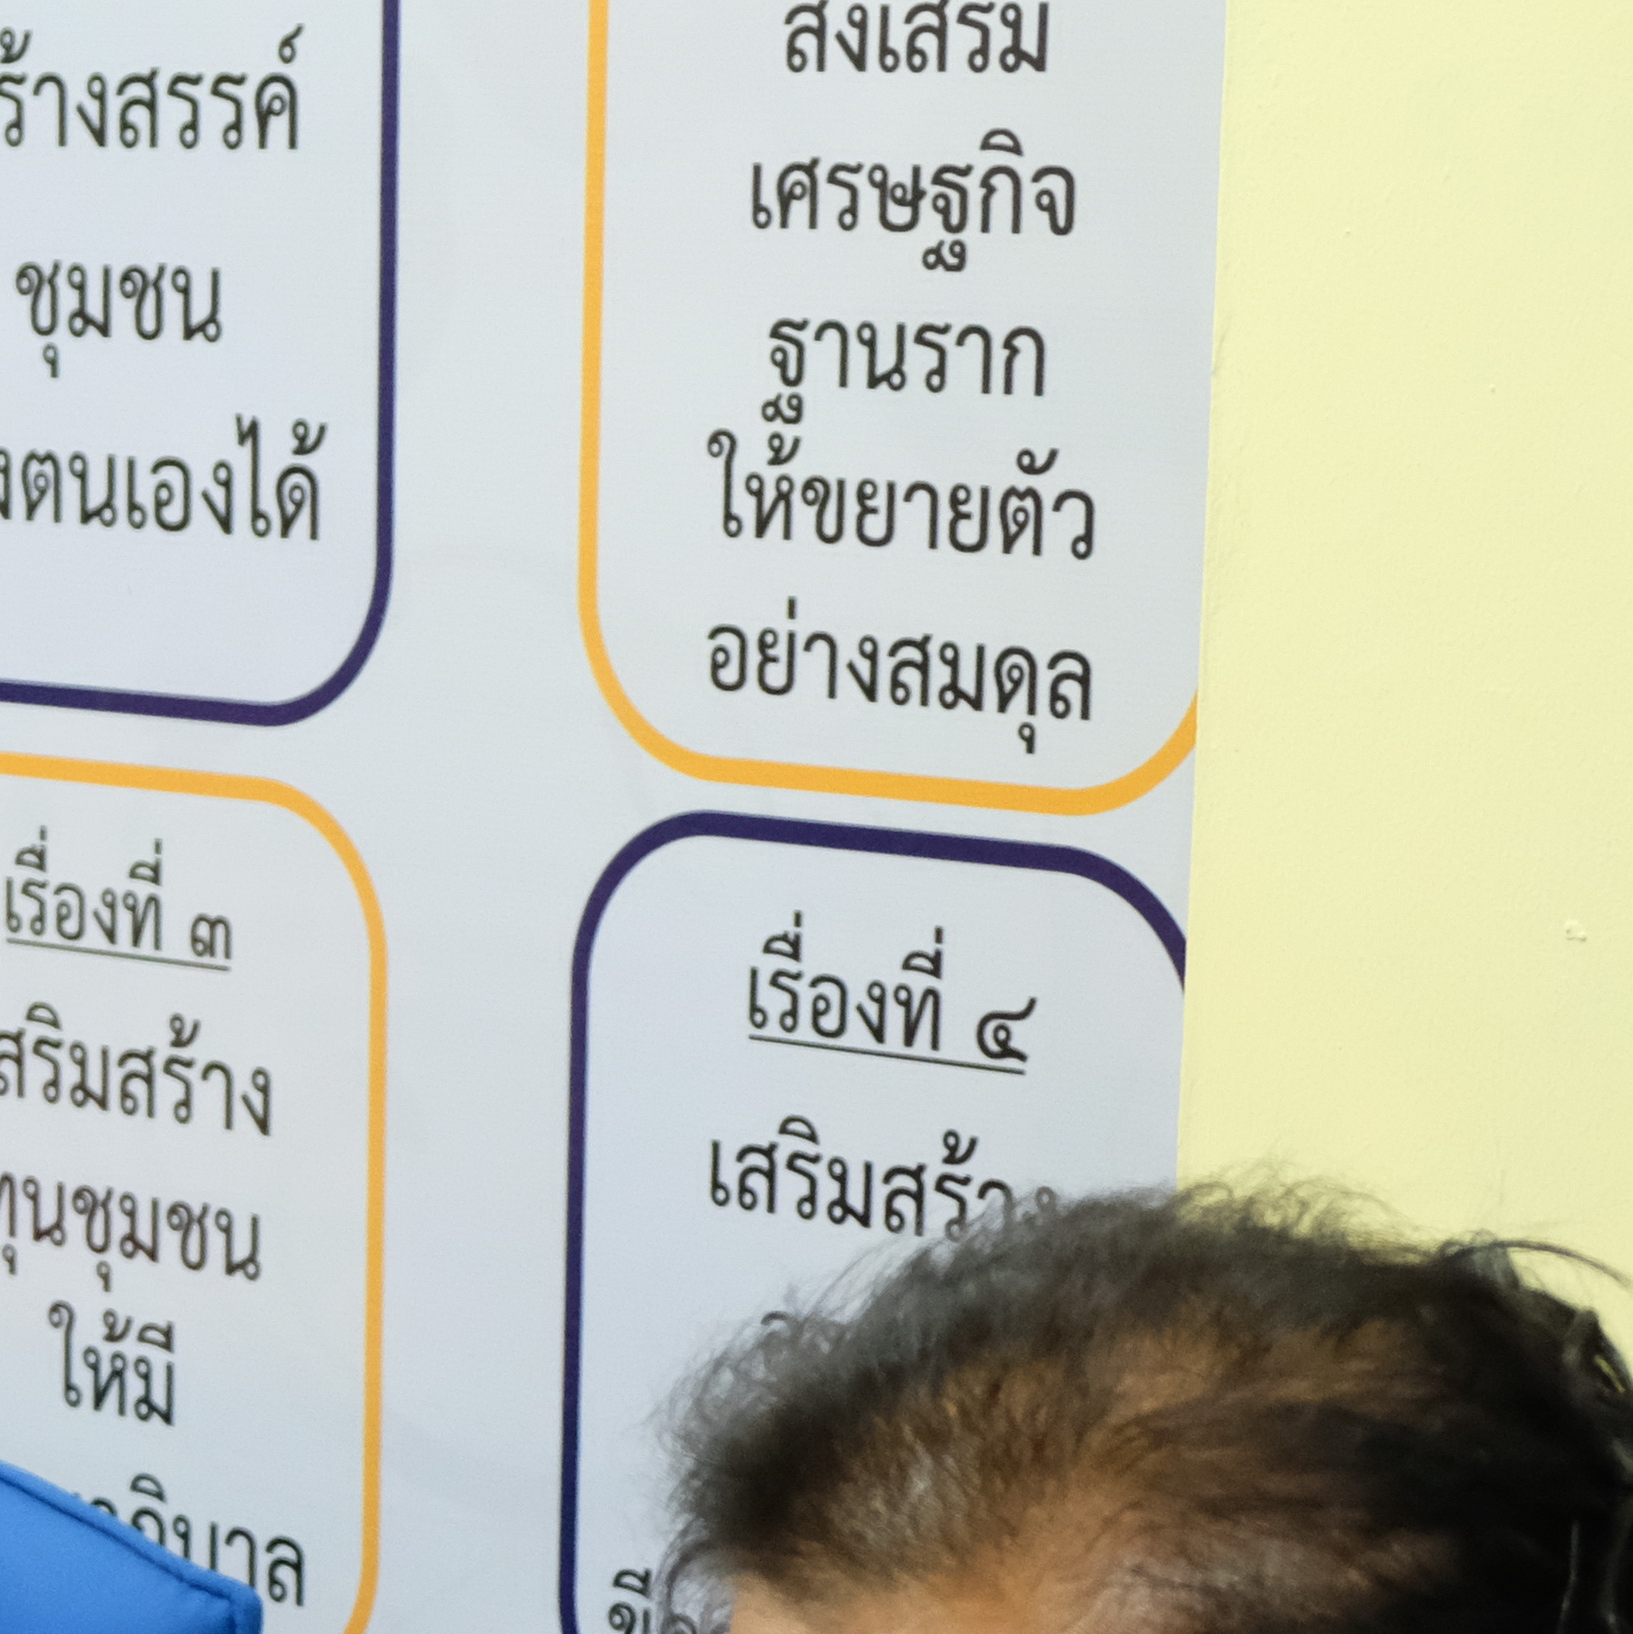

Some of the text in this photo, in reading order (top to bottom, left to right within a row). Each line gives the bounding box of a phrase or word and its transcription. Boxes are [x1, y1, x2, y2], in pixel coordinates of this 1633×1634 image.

[750, 128, 1077, 272] เศรษฐกิจ
[15, 260, 222, 377] ชุมชน
[761, 317, 1046, 425] ฐานราก
[707, 430, 1097, 560] ให้ขยายตัว
[708, 597, 1092, 753] อย่างสมดุล
[4, 827, 232, 959] เรื่องที่ ๓
[747, 911, 1036, 1061] เรื่องที่ ๔
[48, 1301, 175, 1426] ให้มี
